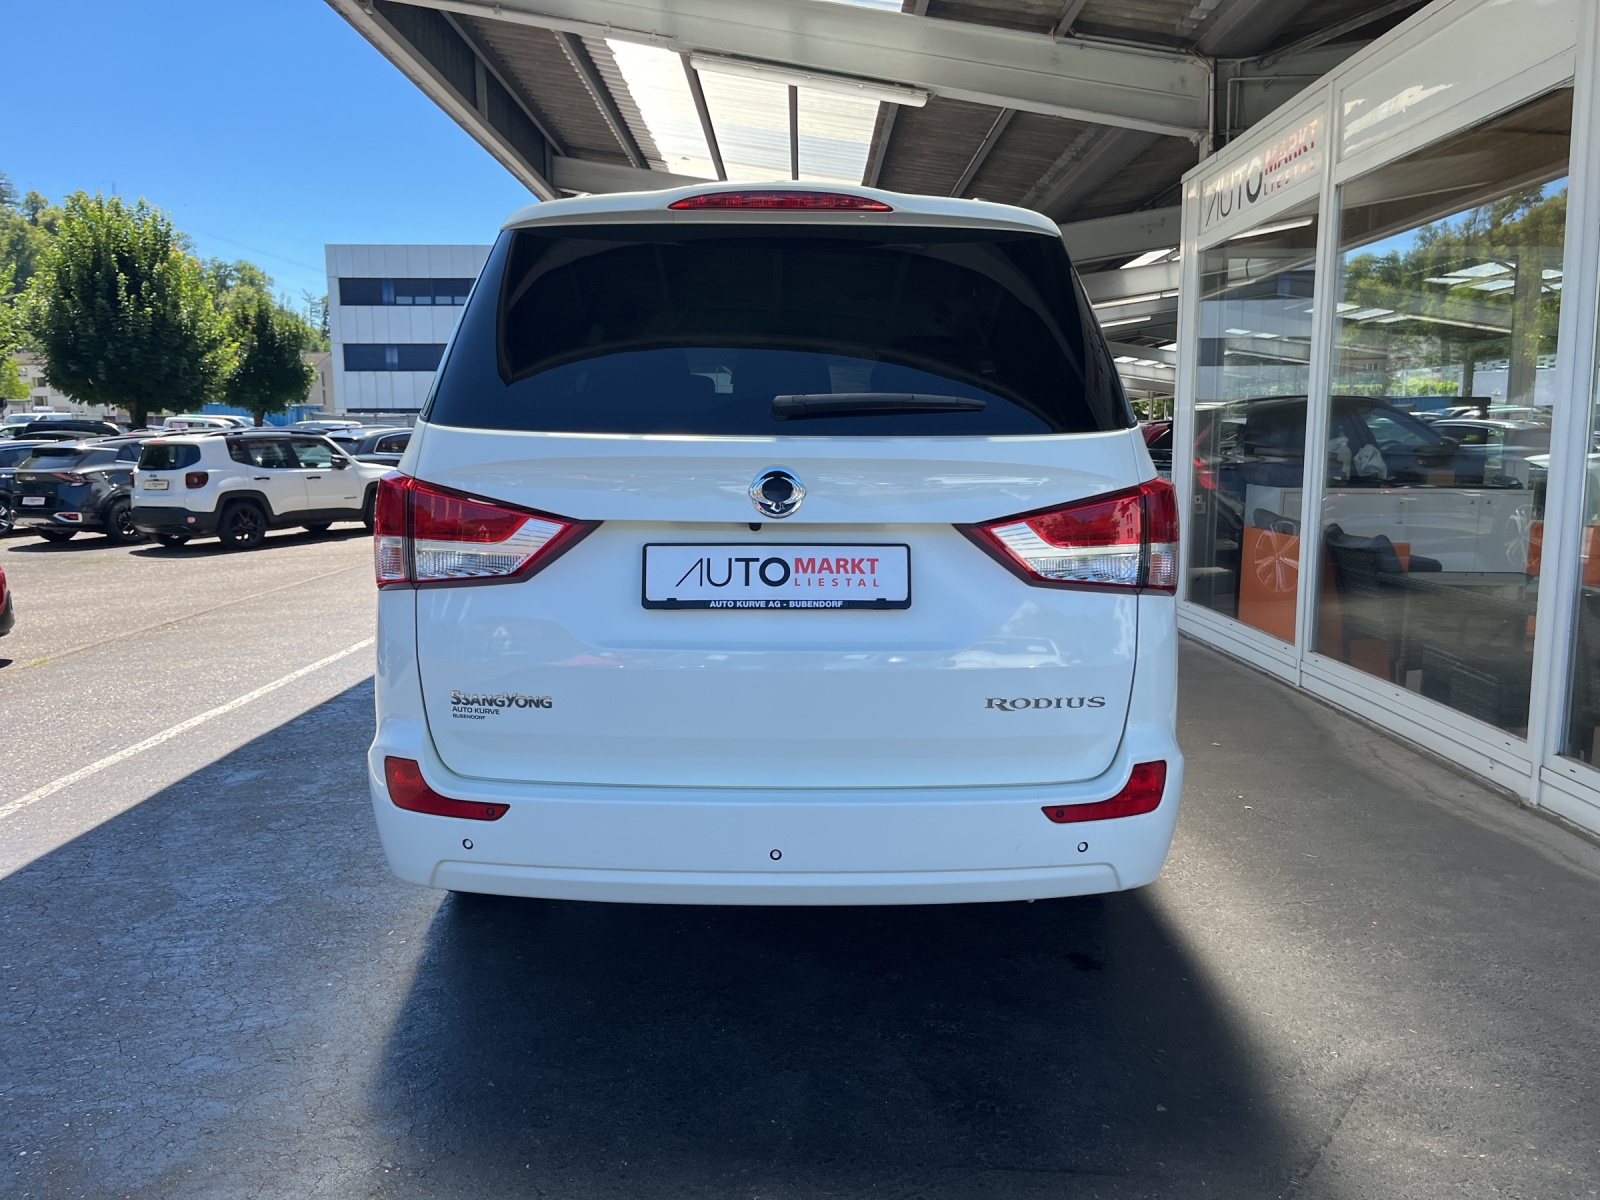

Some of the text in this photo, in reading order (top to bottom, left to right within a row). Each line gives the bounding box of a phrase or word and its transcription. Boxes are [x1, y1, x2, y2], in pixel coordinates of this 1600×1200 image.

[1205, 119, 1318, 228] AUTO MARKT
[1263, 160, 1316, 197] LIESTAL
[675, 557, 879, 587] AUTO MARKT
[794, 577, 879, 587] LIESTAL
[709, 600, 734, 608] AUTO
[736, 600, 766, 608] KURVE
[767, 600, 781, 608] AG
[789, 600, 843, 608] BUBENDORF
[474, 707, 500, 715] KURVE
[984, 696, 1106, 711] RODIUS
